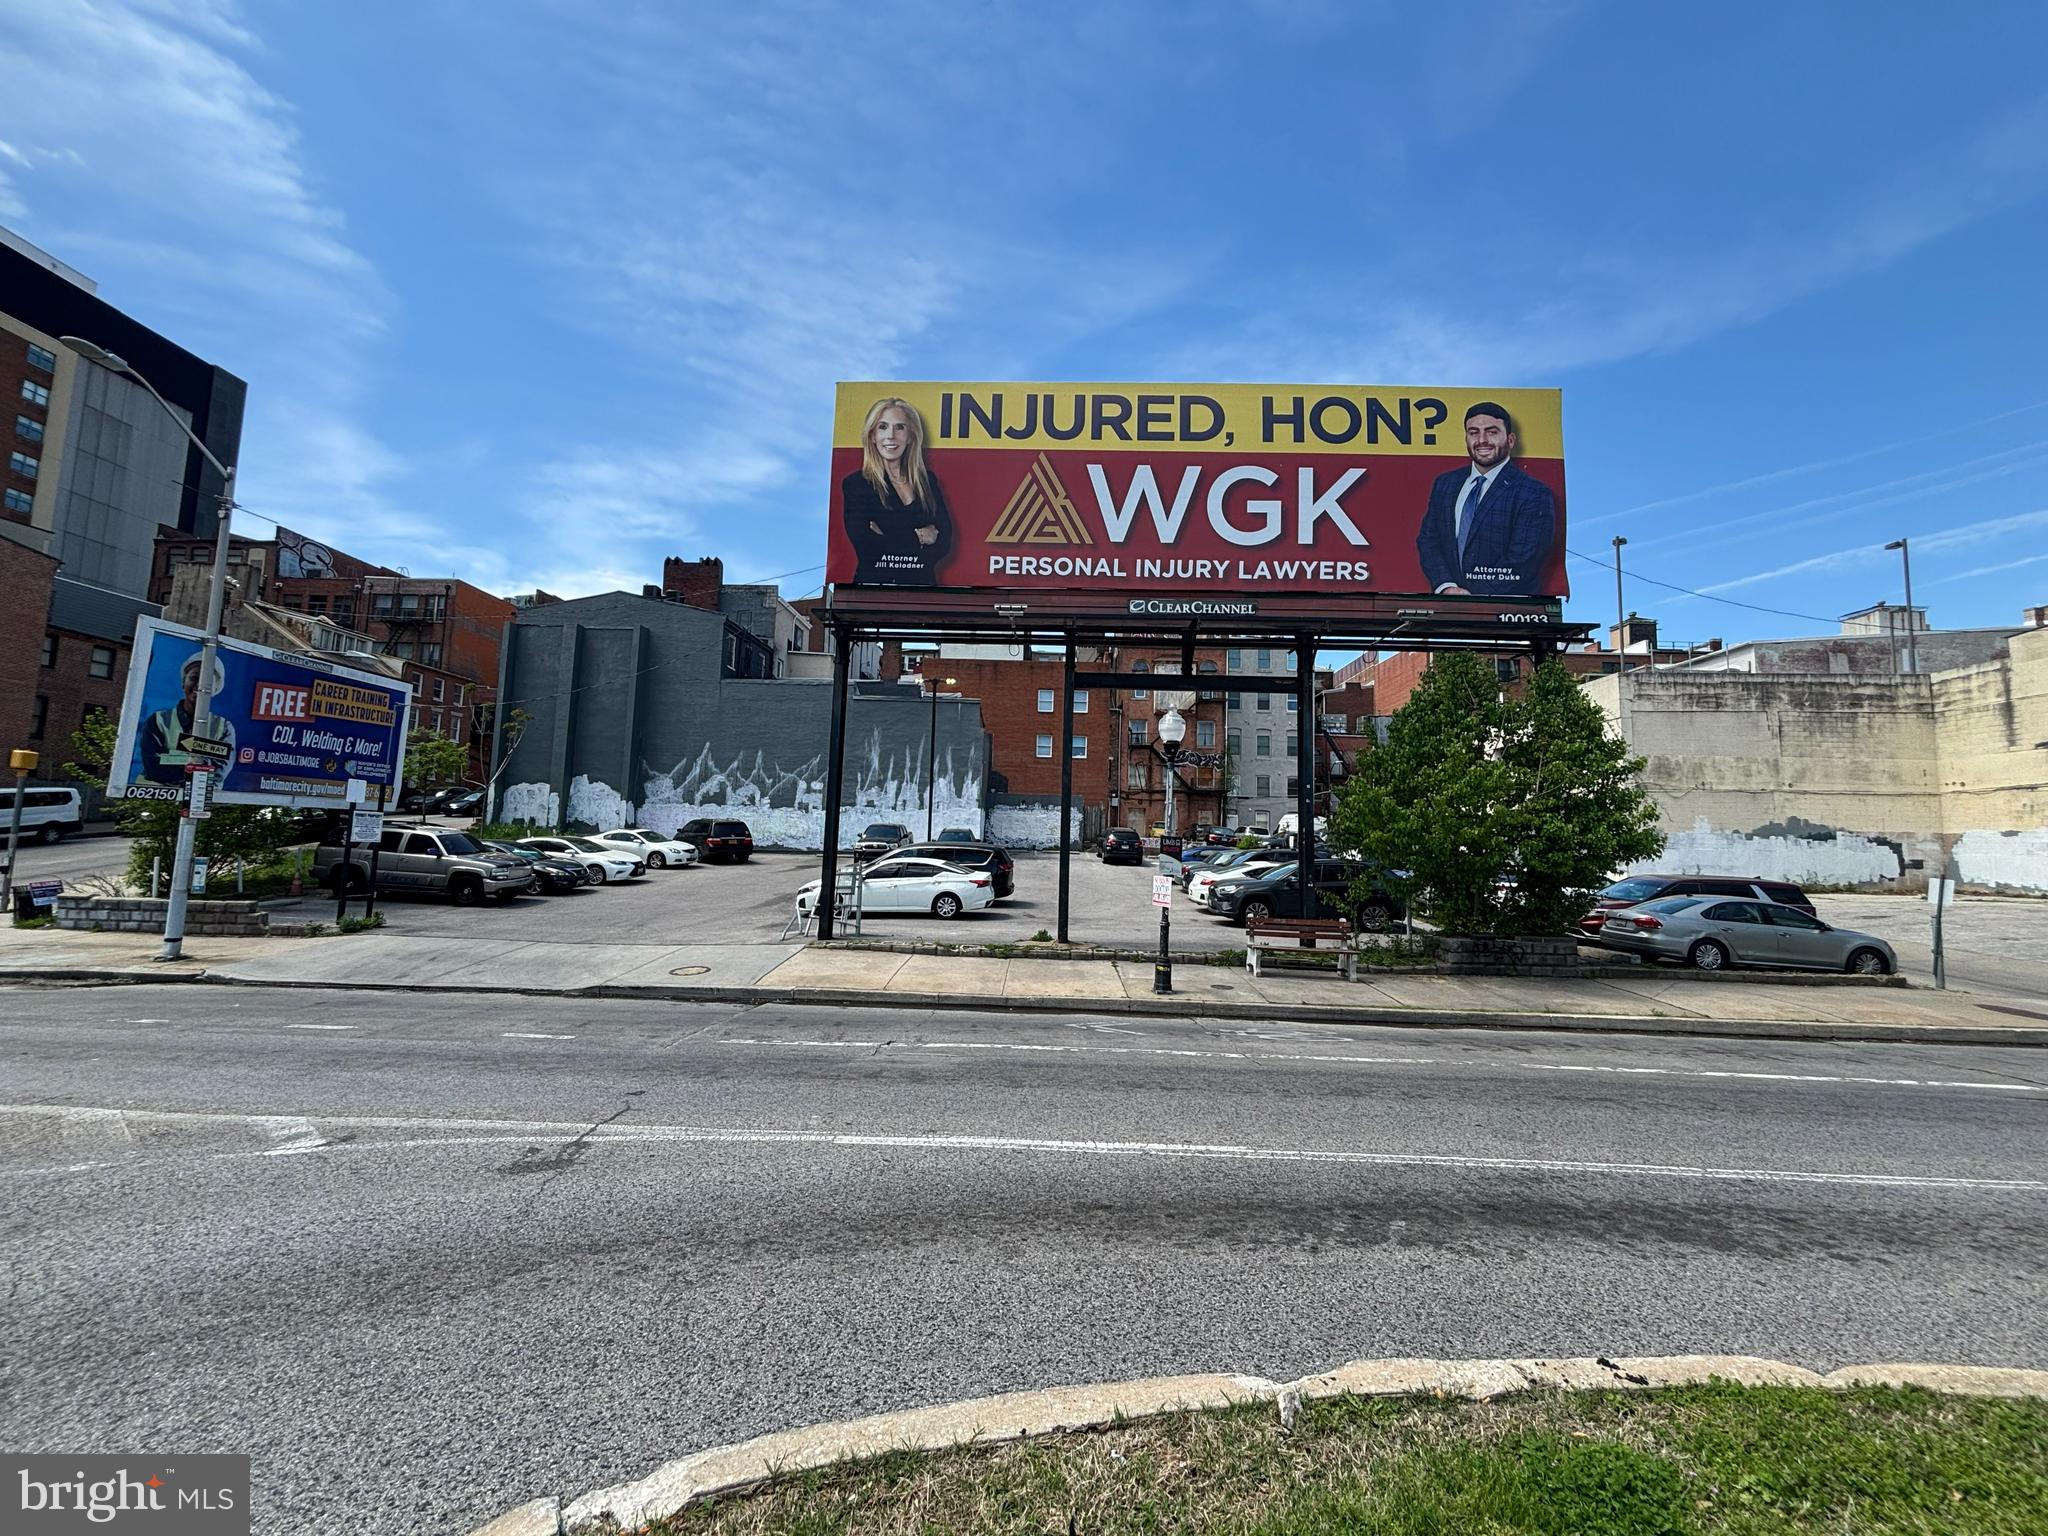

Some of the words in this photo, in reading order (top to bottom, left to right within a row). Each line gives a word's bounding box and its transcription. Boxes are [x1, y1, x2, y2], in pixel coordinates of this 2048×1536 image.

[940, 393, 1234, 446] INJURED,
[1262, 396, 1448, 445] HON?
[1087, 464, 1369, 546] WGK
[881, 554, 918, 562] Attorney
[989, 555, 1126, 577] PERSONAL
[1136, 559, 1230, 579] INJURY
[1238, 560, 1369, 580] LAWYERS
[1474, 566, 1512, 574] Attorney
[259, 687, 308, 718] FREE
[314, 682, 348, 700] CAREER
[351, 688, 388, 707] TRAINING
[311, 699, 322, 712] IN
[325, 700, 394, 724] INFRASTRUCTURE
[193, 741, 208, 751] ONE
[209, 744, 226, 754] WAY
[272, 725, 298, 747] CDL,
[301, 729, 344, 755] Welding
[345, 737, 353, 752] &
[354, 738, 382, 757] More!
[257, 750, 320, 768] @JOBSBALTIMORE
[126, 786, 177, 800] 062150
